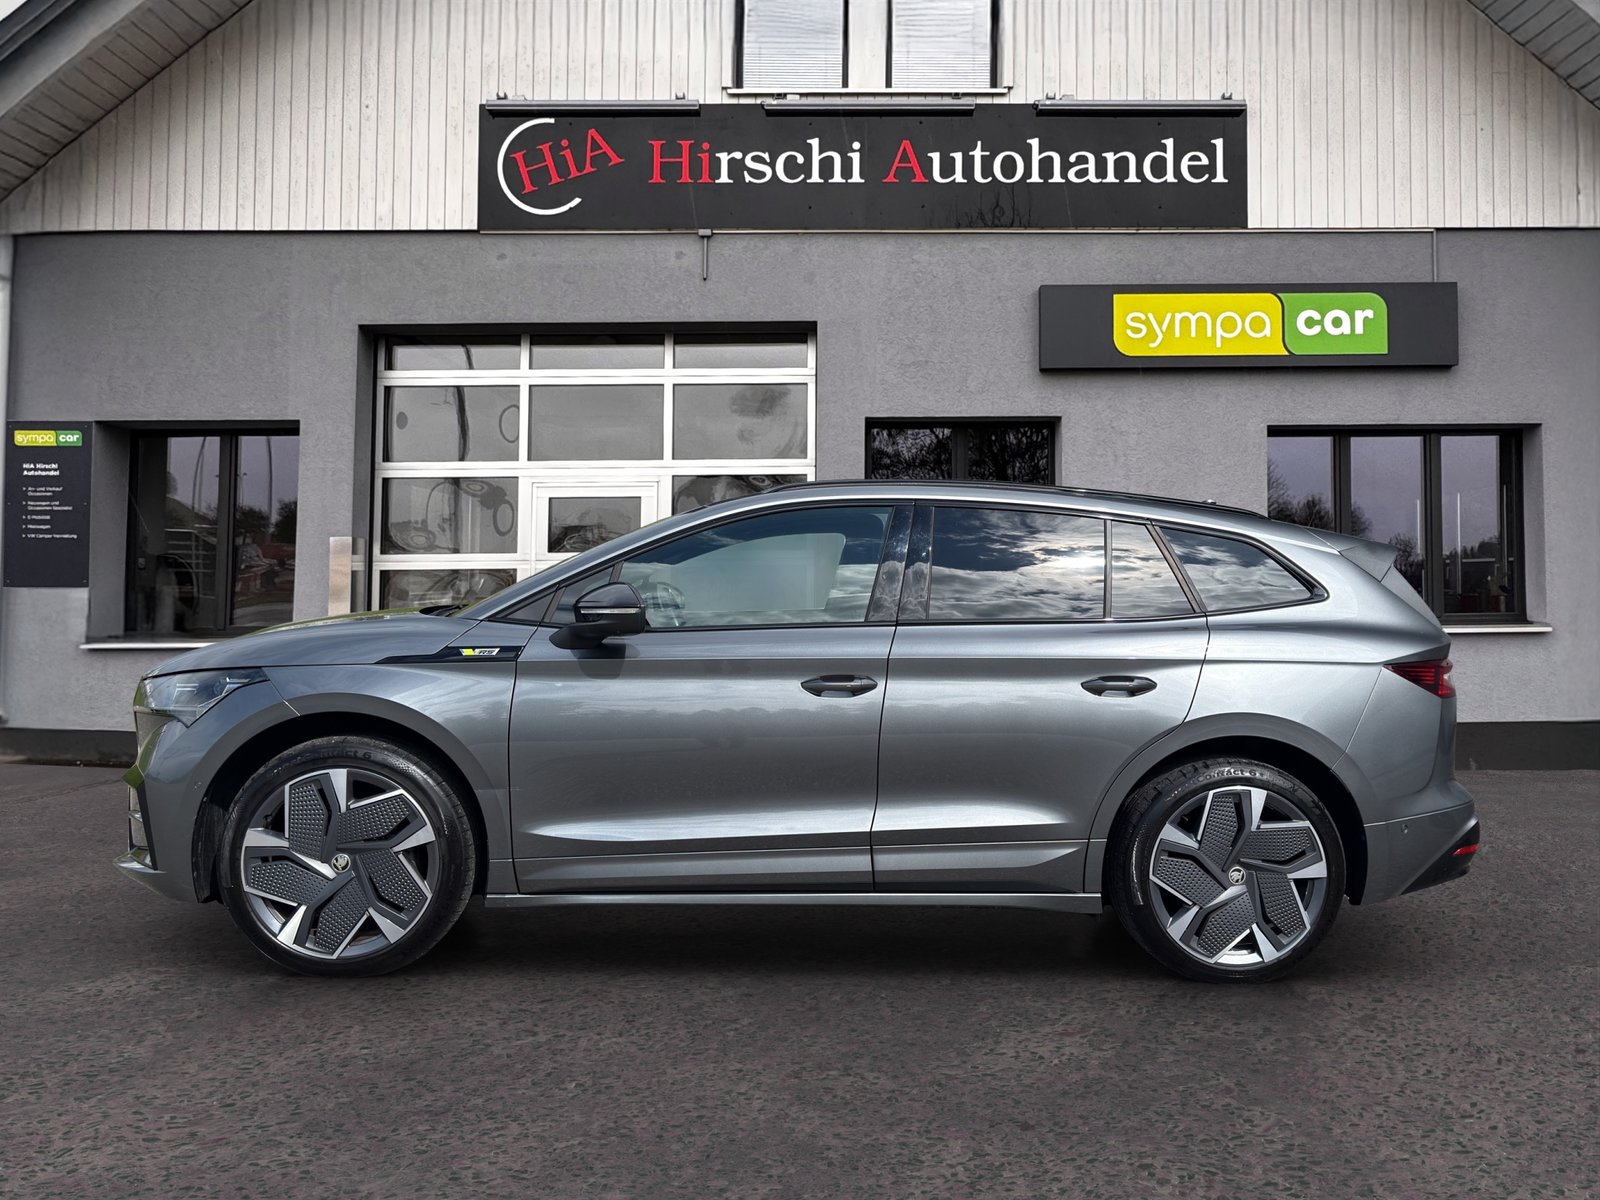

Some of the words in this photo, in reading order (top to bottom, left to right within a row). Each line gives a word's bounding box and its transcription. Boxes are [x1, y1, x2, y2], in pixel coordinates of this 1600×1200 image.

[509, 127, 625, 195] HiA
[648, 138, 866, 185] Hirschi
[882, 137, 1229, 184] Autohandel
[1125, 309, 1271, 348] sympa
[1296, 308, 1375, 336] car
[16, 433, 54, 444] sympa
[59, 433, 80, 442] car
